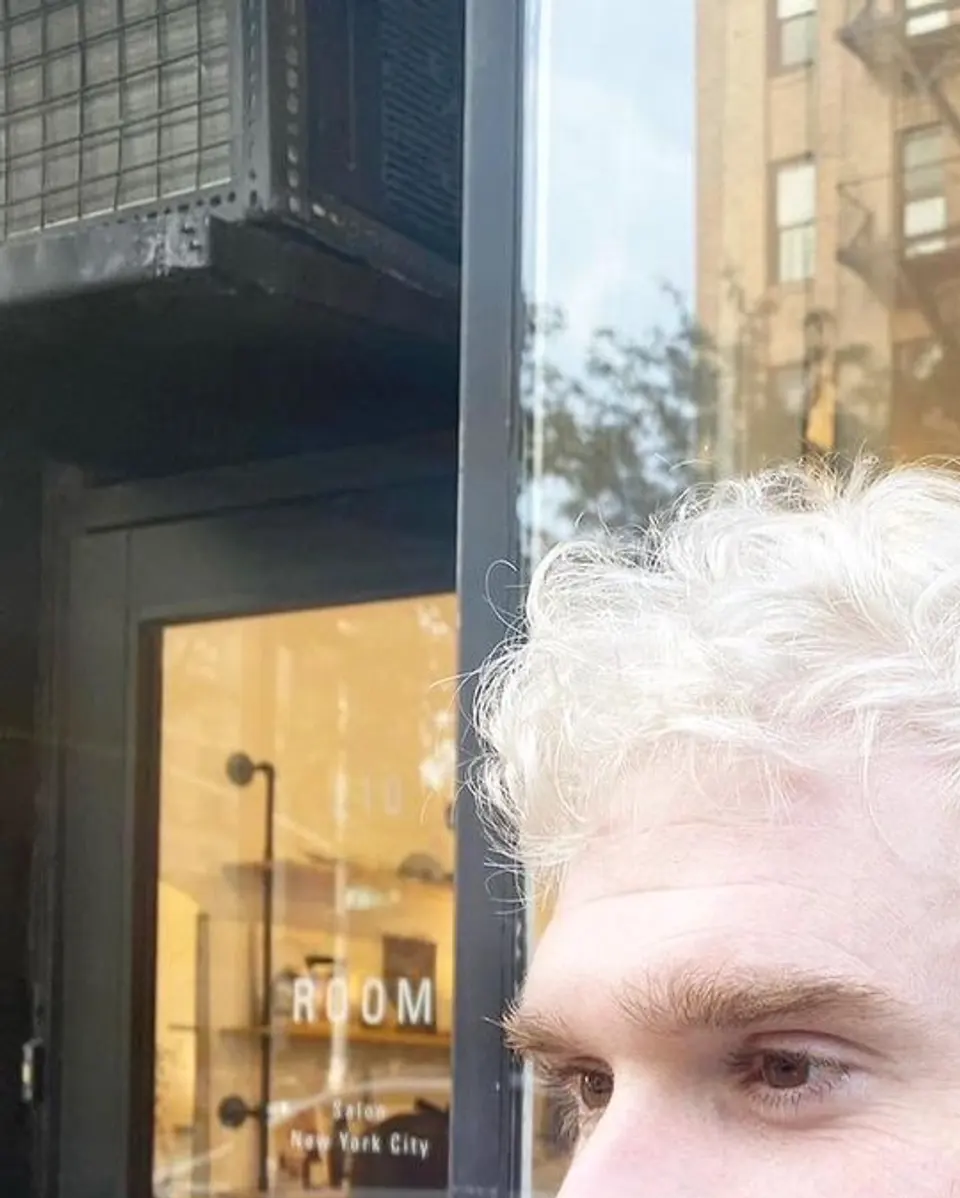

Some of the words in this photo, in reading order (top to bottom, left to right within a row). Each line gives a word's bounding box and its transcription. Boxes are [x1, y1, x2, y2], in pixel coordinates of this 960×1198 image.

[293, 976, 432, 1025] ROOM
[333, 1098, 387, 1121] Salon
[290, 1129, 331, 1152] New
[339, 1130, 381, 1153] York
[390, 1132, 429, 1160] City
